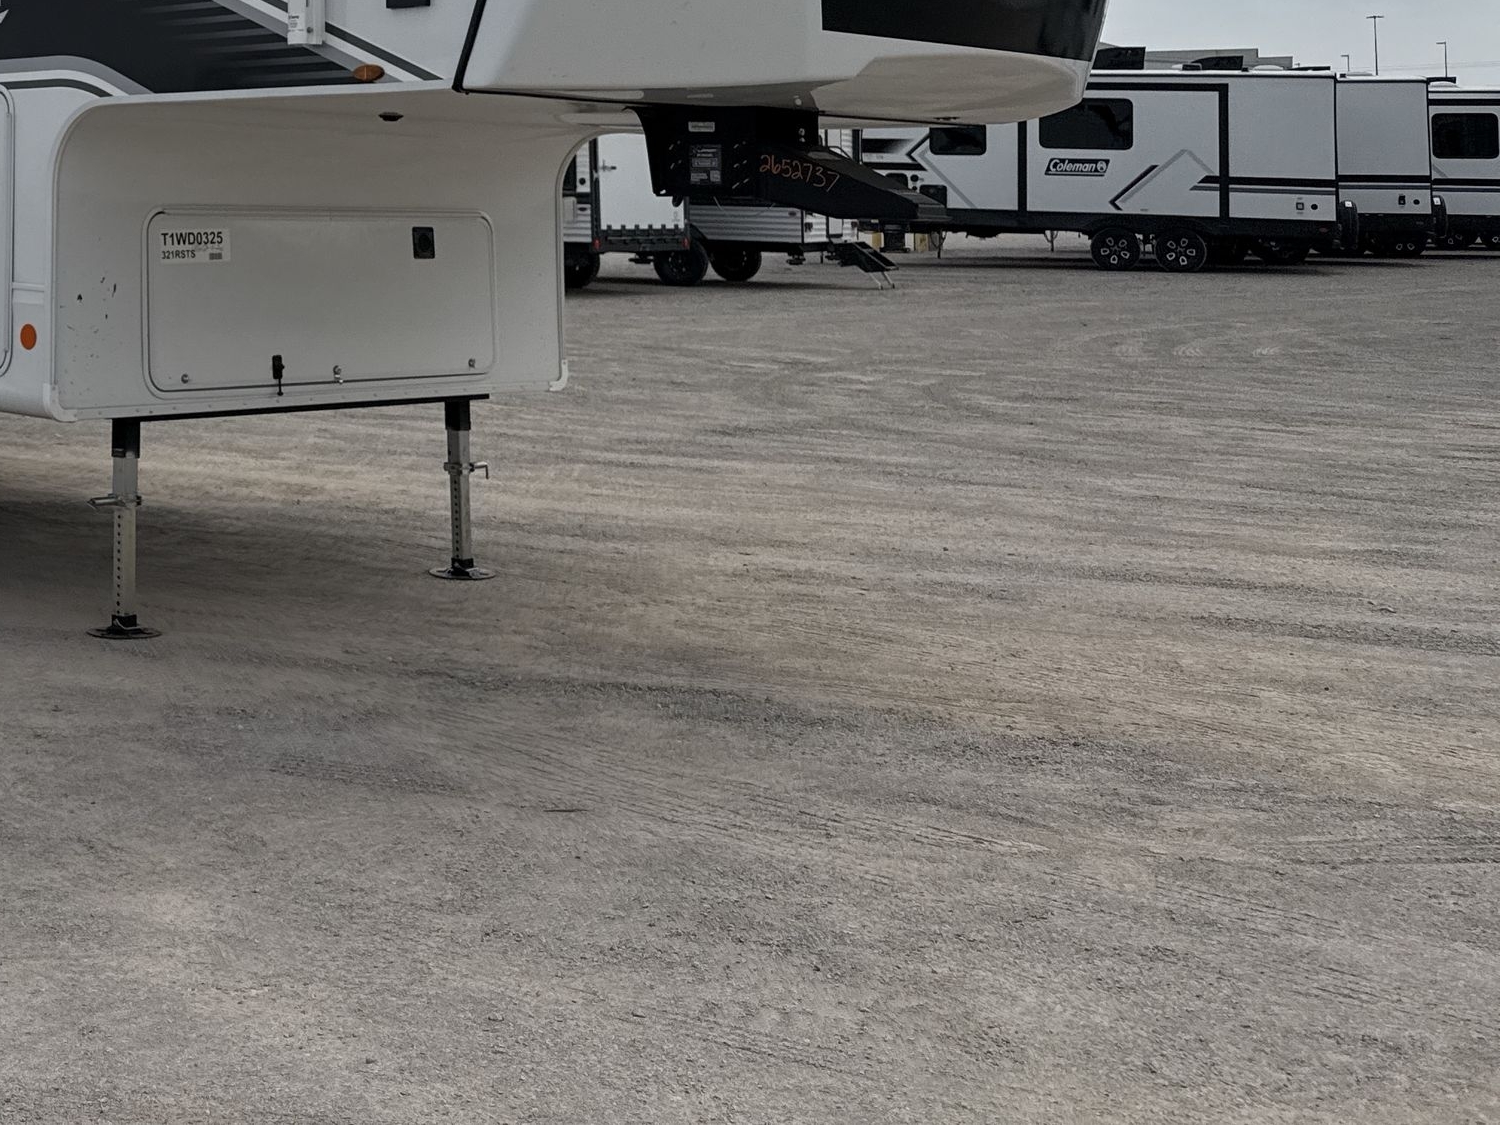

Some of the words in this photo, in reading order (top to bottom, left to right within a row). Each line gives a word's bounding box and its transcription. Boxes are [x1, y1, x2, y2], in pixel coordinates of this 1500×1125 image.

[1049, 159, 1097, 172] Coleman
[759, 154, 841, 193] 2652737
[161, 231, 223, 246] T1WD0325
[161, 250, 196, 259] 321RSTS
